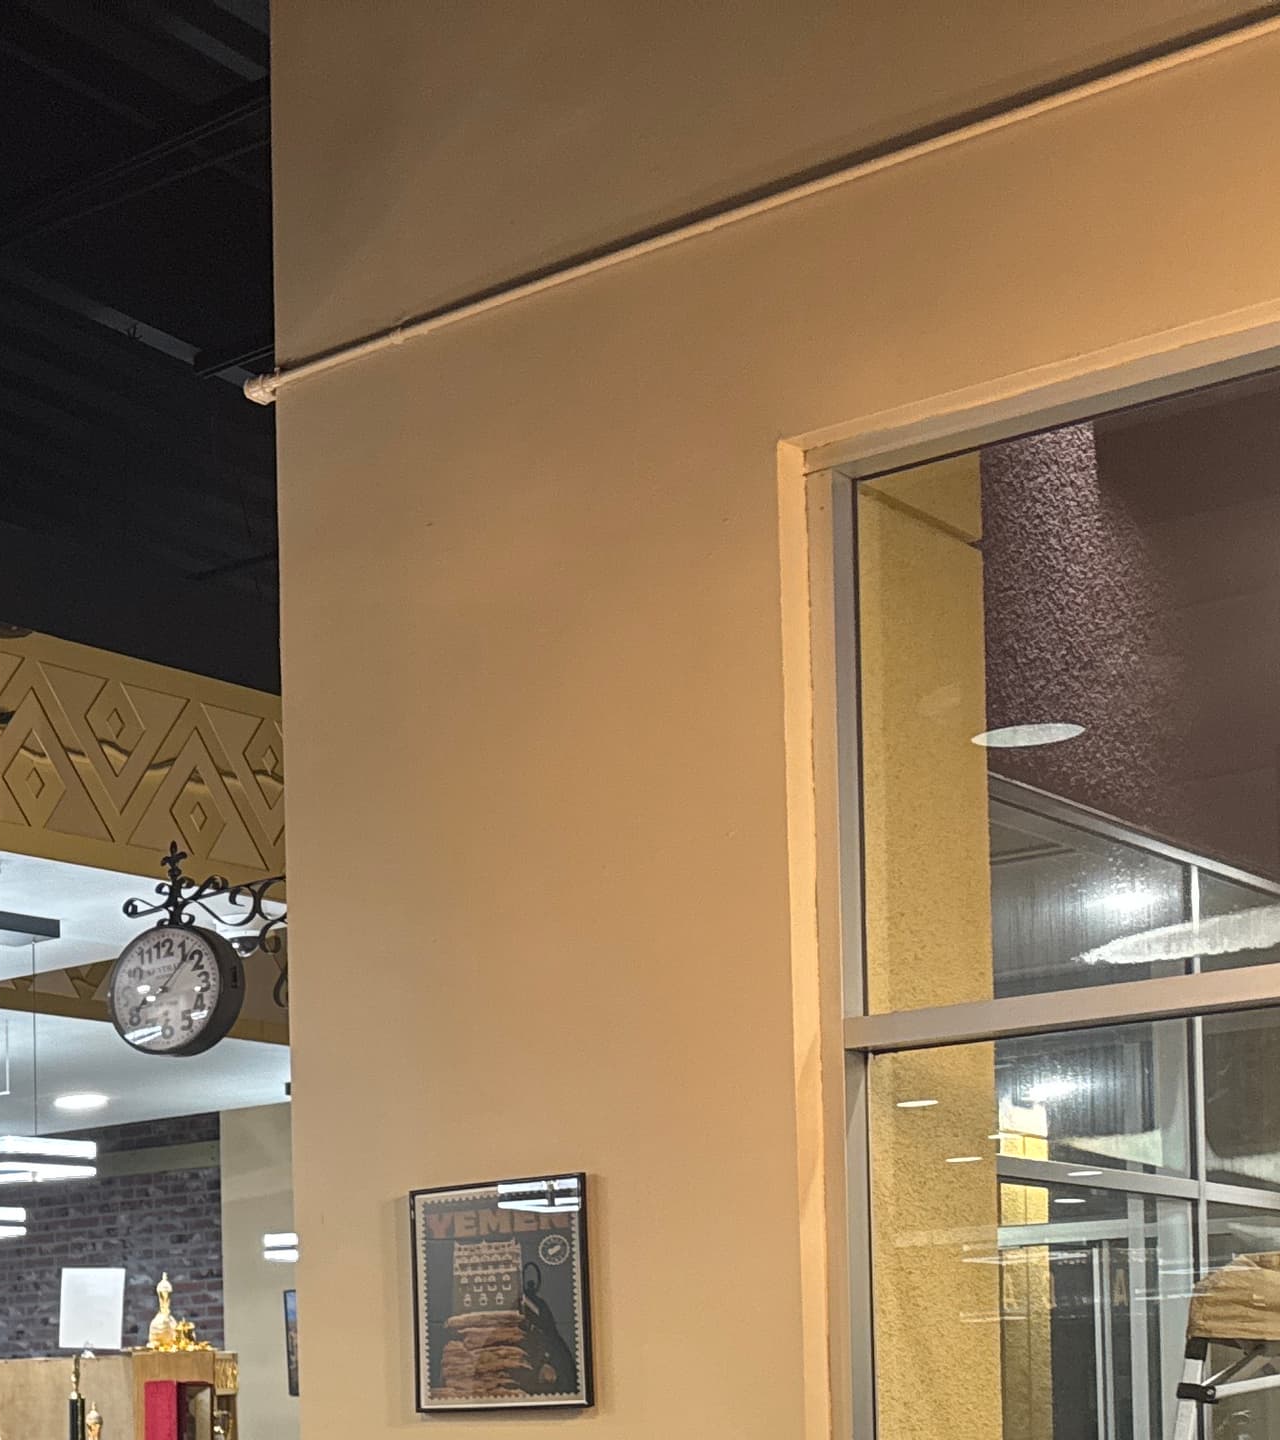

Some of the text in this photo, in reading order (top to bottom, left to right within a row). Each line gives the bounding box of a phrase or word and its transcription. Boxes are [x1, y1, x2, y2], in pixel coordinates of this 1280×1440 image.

[137, 947, 152, 964] 11
[154, 938, 174, 959] 12
[190, 949, 204, 971] 2
[197, 971, 211, 992] 3
[194, 993, 205, 1012] 4
